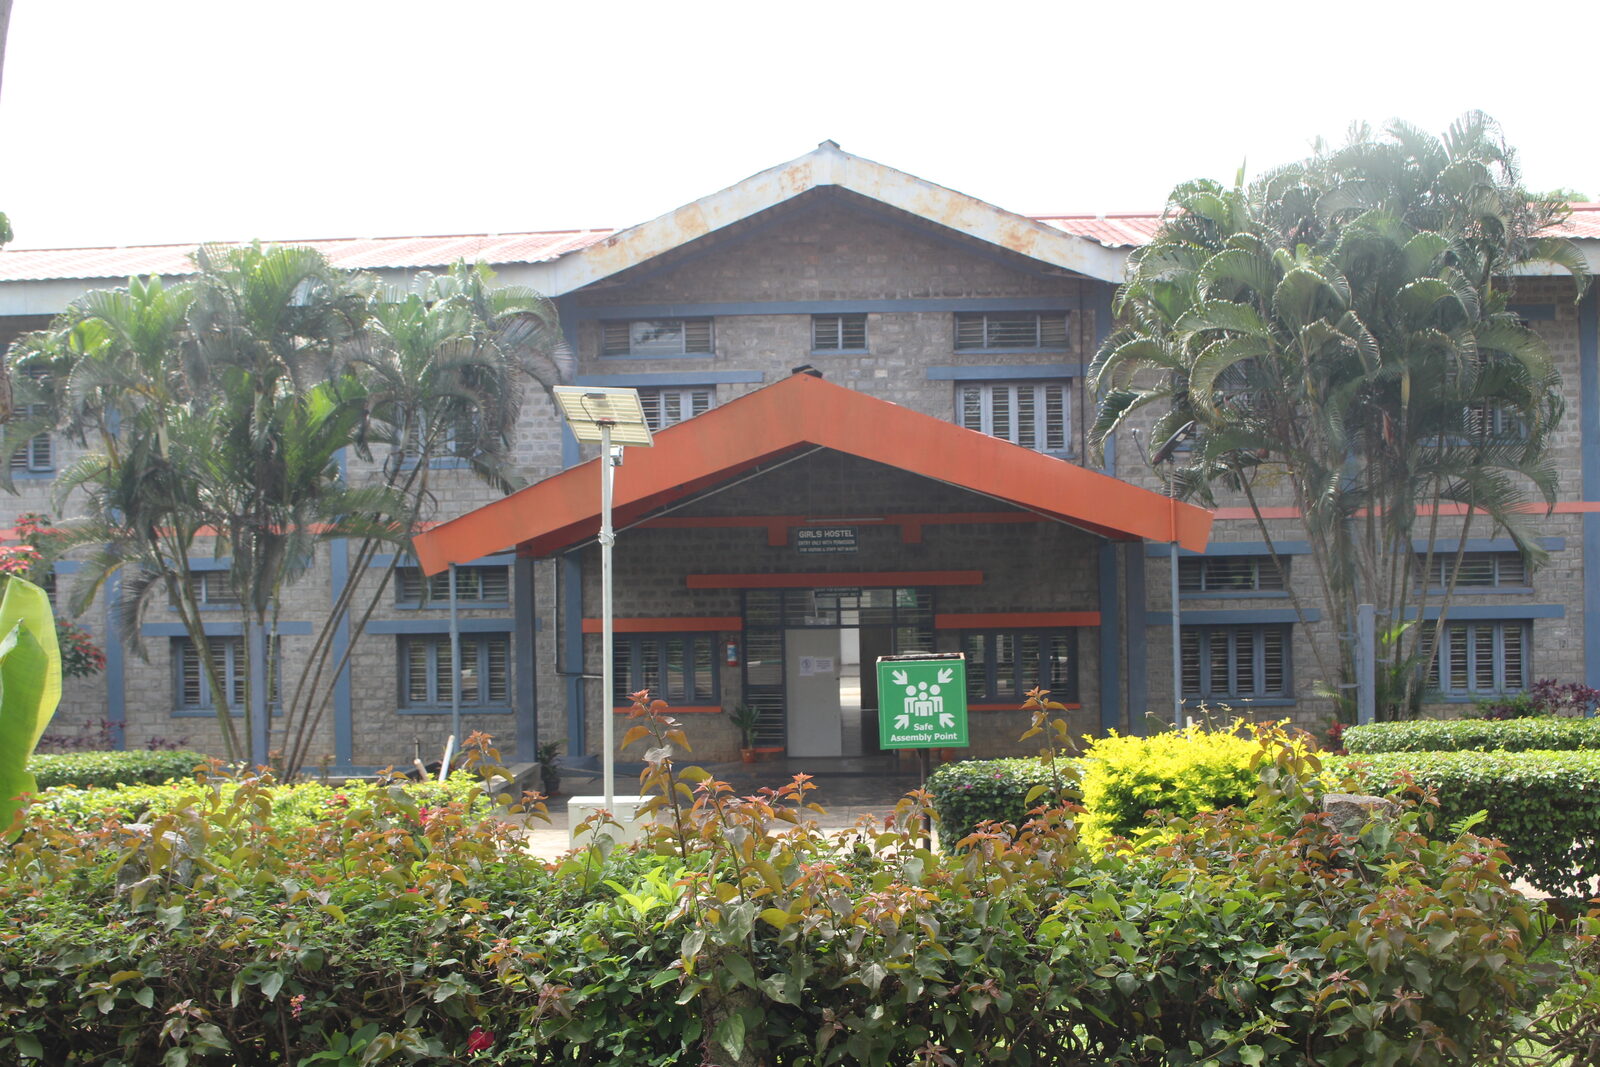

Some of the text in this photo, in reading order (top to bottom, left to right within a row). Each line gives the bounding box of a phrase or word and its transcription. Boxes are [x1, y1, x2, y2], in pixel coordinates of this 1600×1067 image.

[799, 529, 854, 538] GIRLS HOSTEL
[913, 723, 934, 731] Safe
[890, 732, 958, 742] Assembly Point
